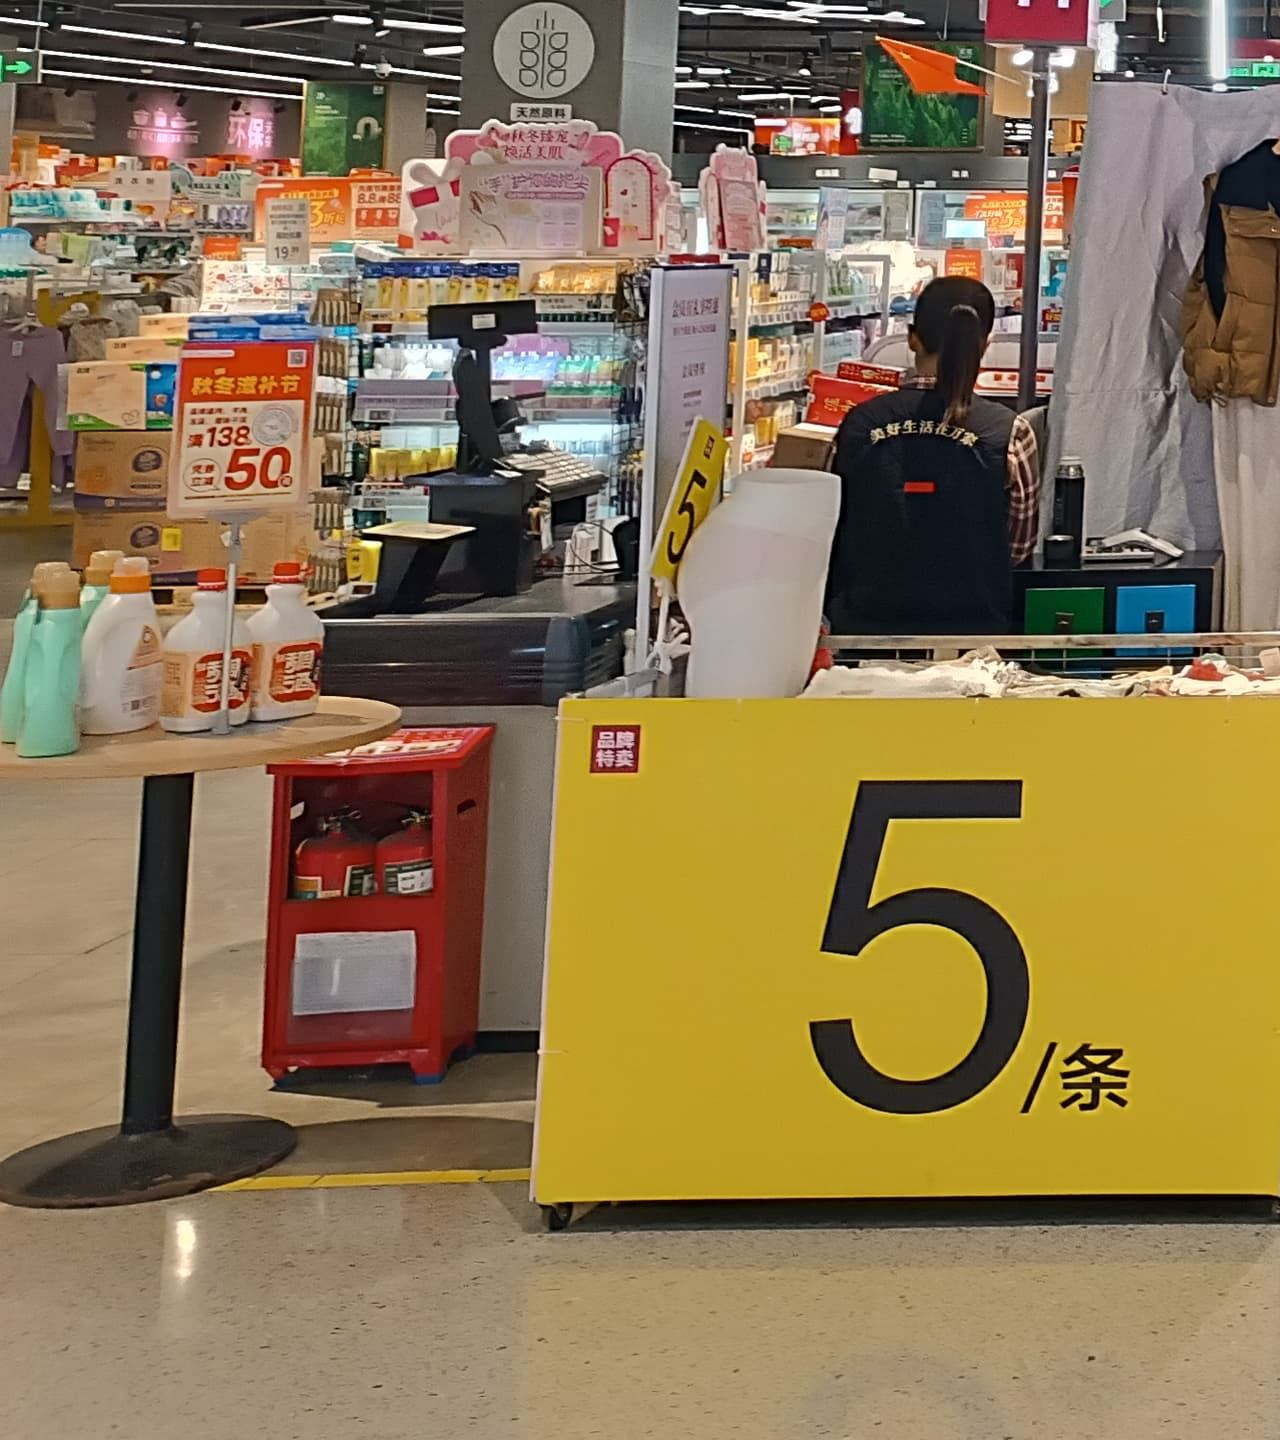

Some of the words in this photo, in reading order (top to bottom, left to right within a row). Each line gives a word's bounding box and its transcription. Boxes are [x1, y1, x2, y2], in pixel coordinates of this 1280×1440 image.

[516, 106, 567, 119] 天然原料
[191, 374, 301, 396] 秋冬滋补节
[870, 419, 979, 448] 美好生活在万家
[224, 446, 292, 491] 50
[667, 468, 708, 565] 5
[597, 731, 636, 749] 品牌
[595, 749, 635, 768] 特卖
